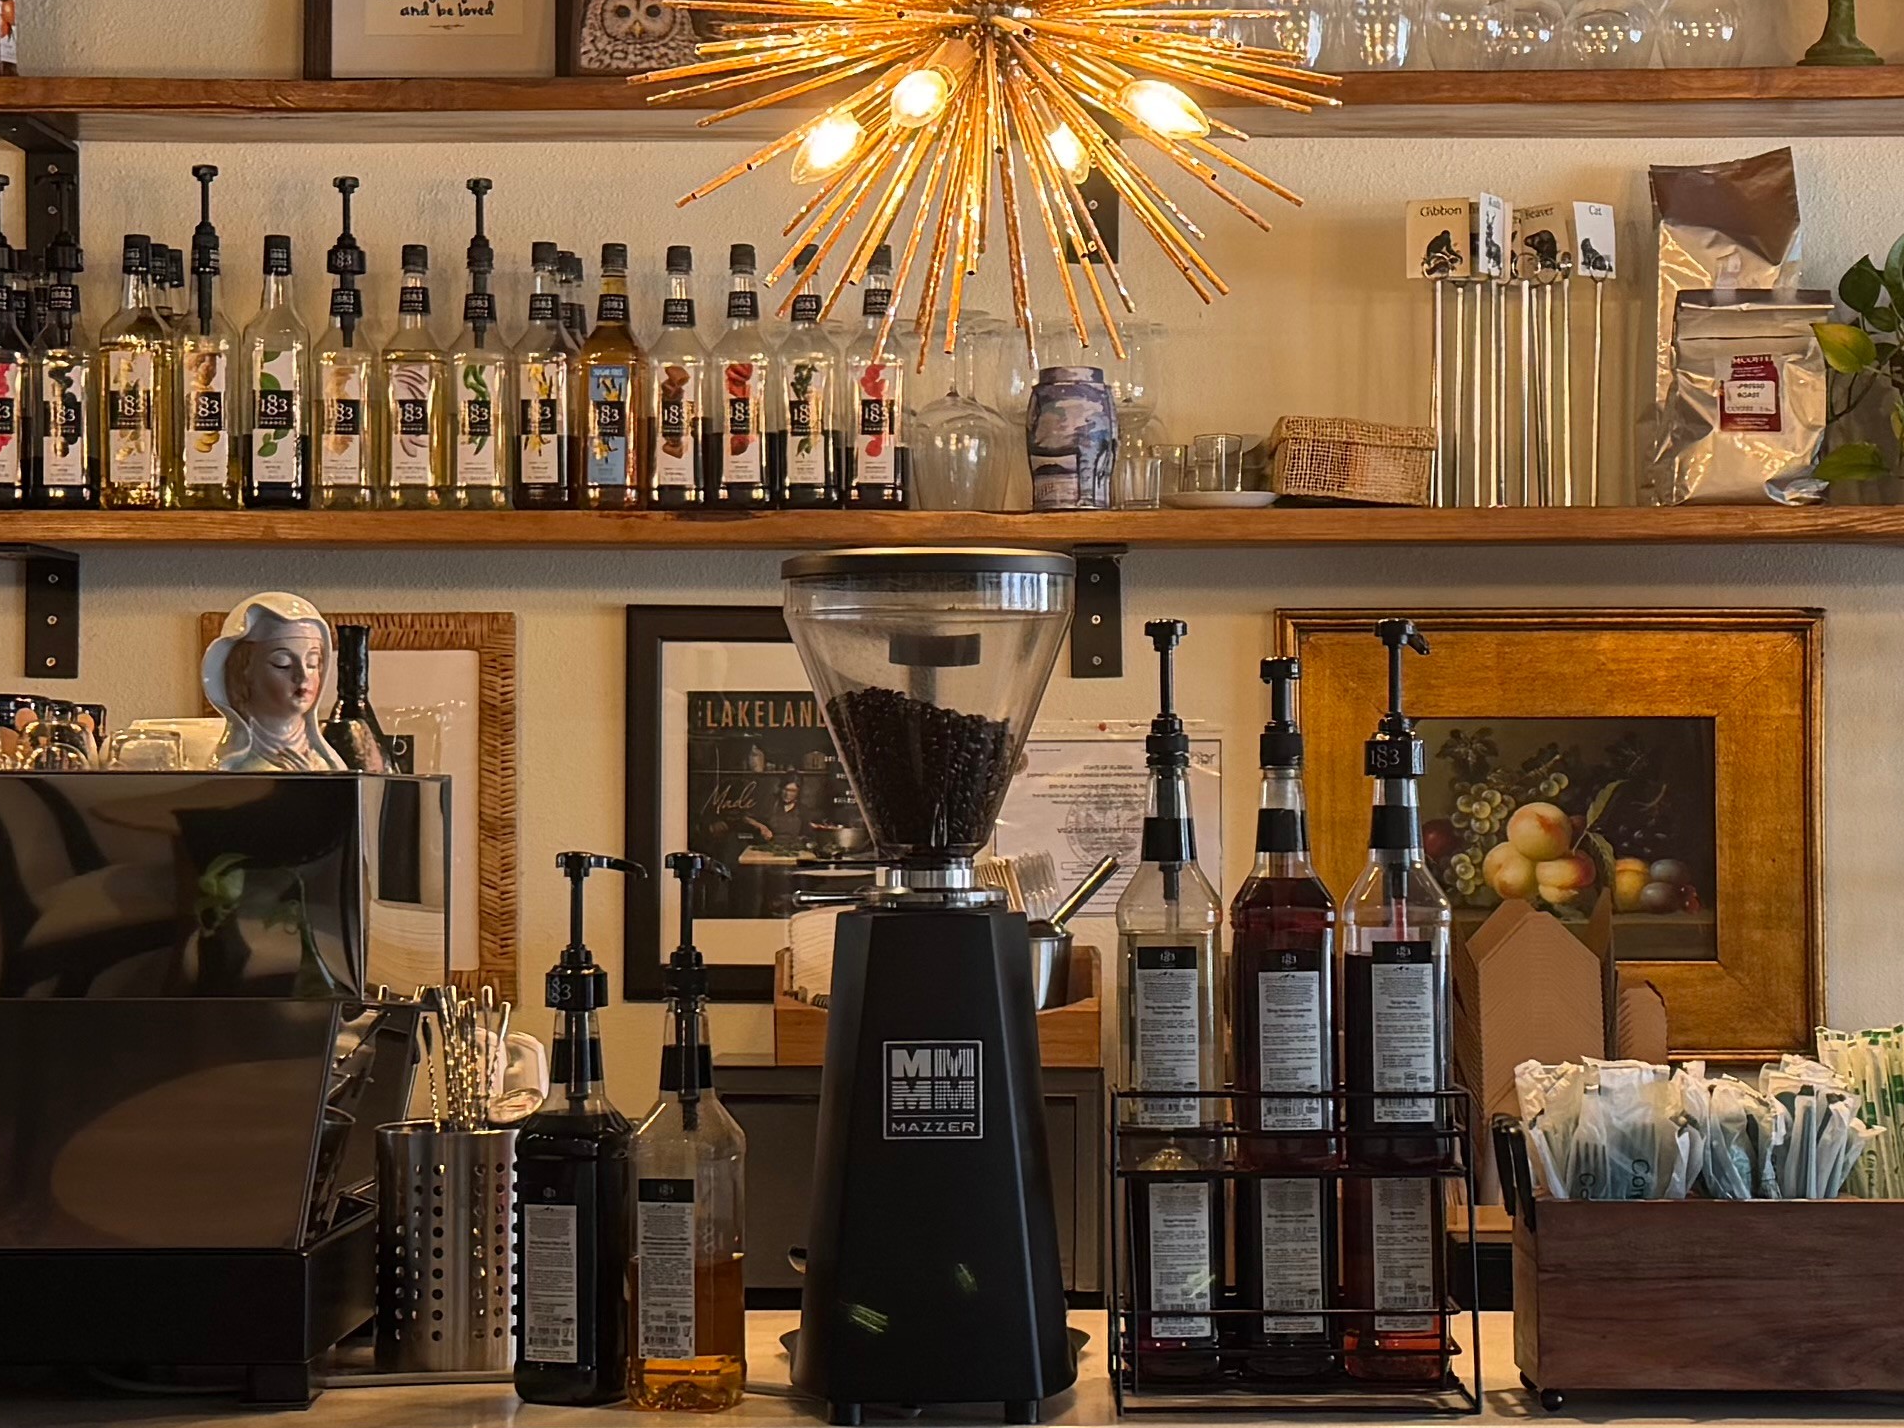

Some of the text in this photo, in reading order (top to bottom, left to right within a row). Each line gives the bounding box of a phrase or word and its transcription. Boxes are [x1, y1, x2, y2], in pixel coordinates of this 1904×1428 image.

[399, 0, 495, 18] and be loved
[1420, 205, 1463, 218] Gibbon
[259, 394, 288, 416] 1883
[891, 1121, 976, 1133] MAZZER
